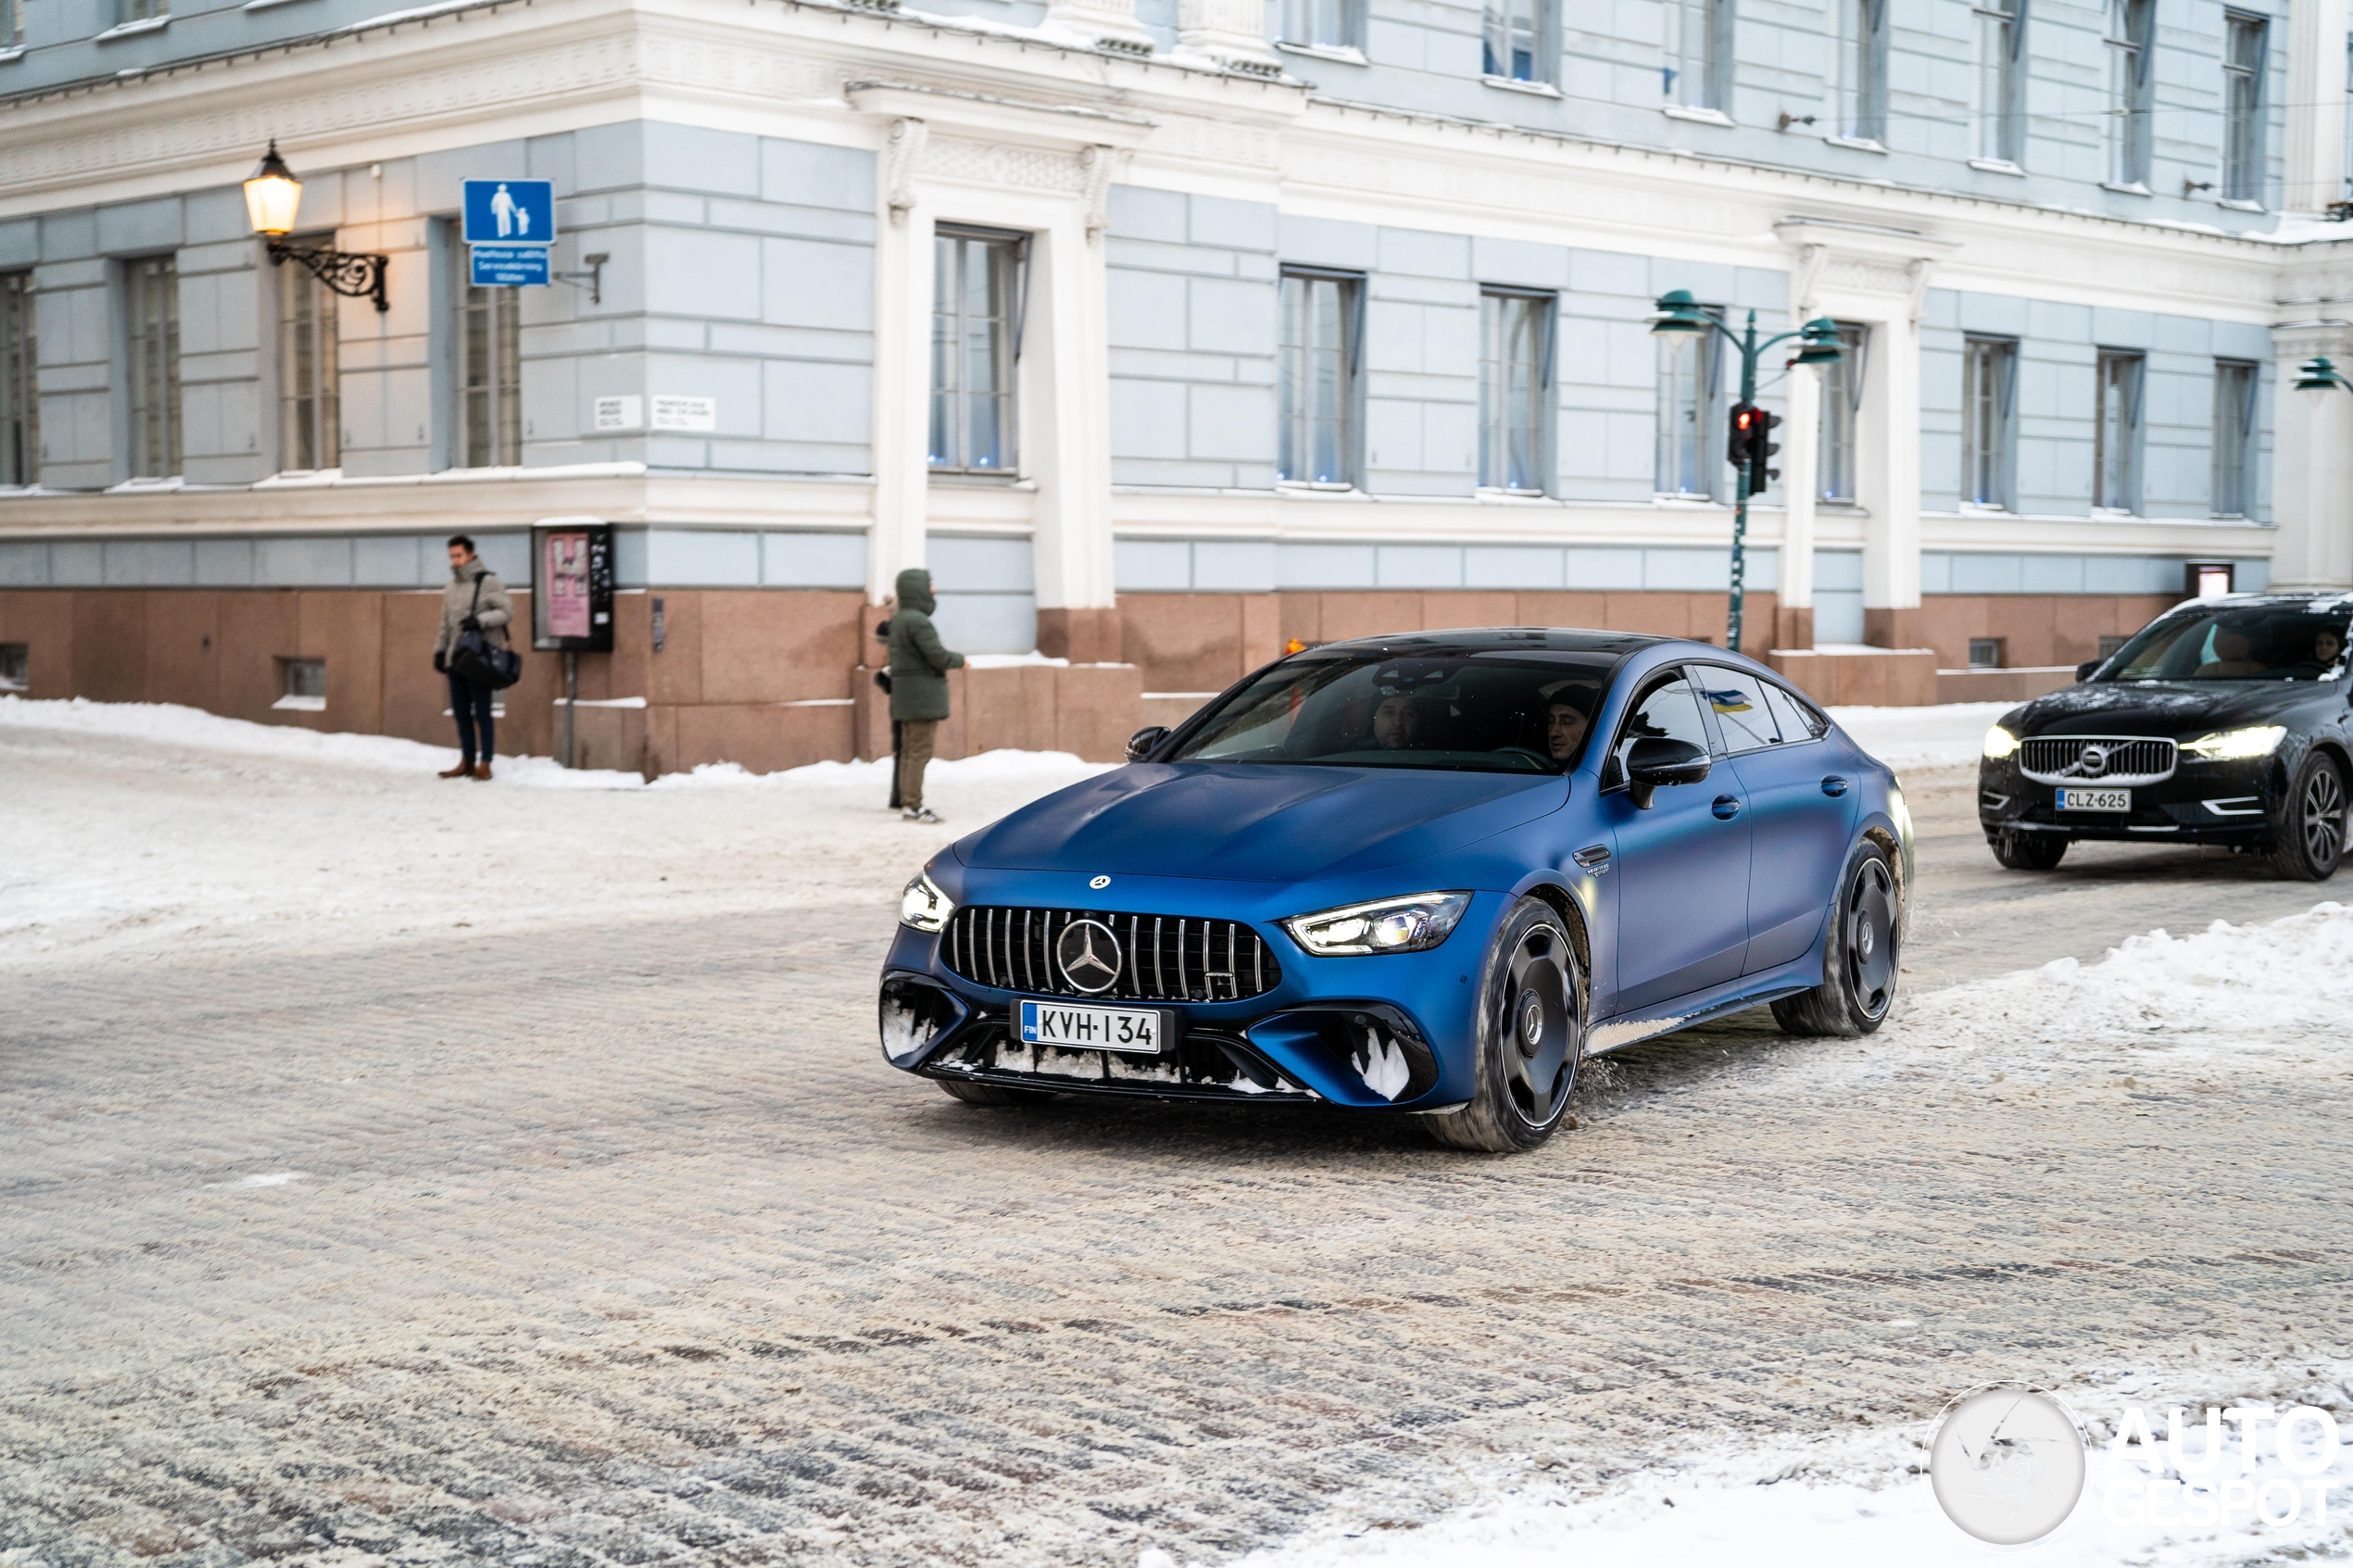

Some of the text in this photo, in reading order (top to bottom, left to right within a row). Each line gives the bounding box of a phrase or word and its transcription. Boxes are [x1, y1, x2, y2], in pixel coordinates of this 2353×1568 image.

[2067, 793, 2126, 808] CLZ-625
[1024, 1024, 1037, 1035] FIN
[1042, 1010, 1151, 1045] KVH-134
